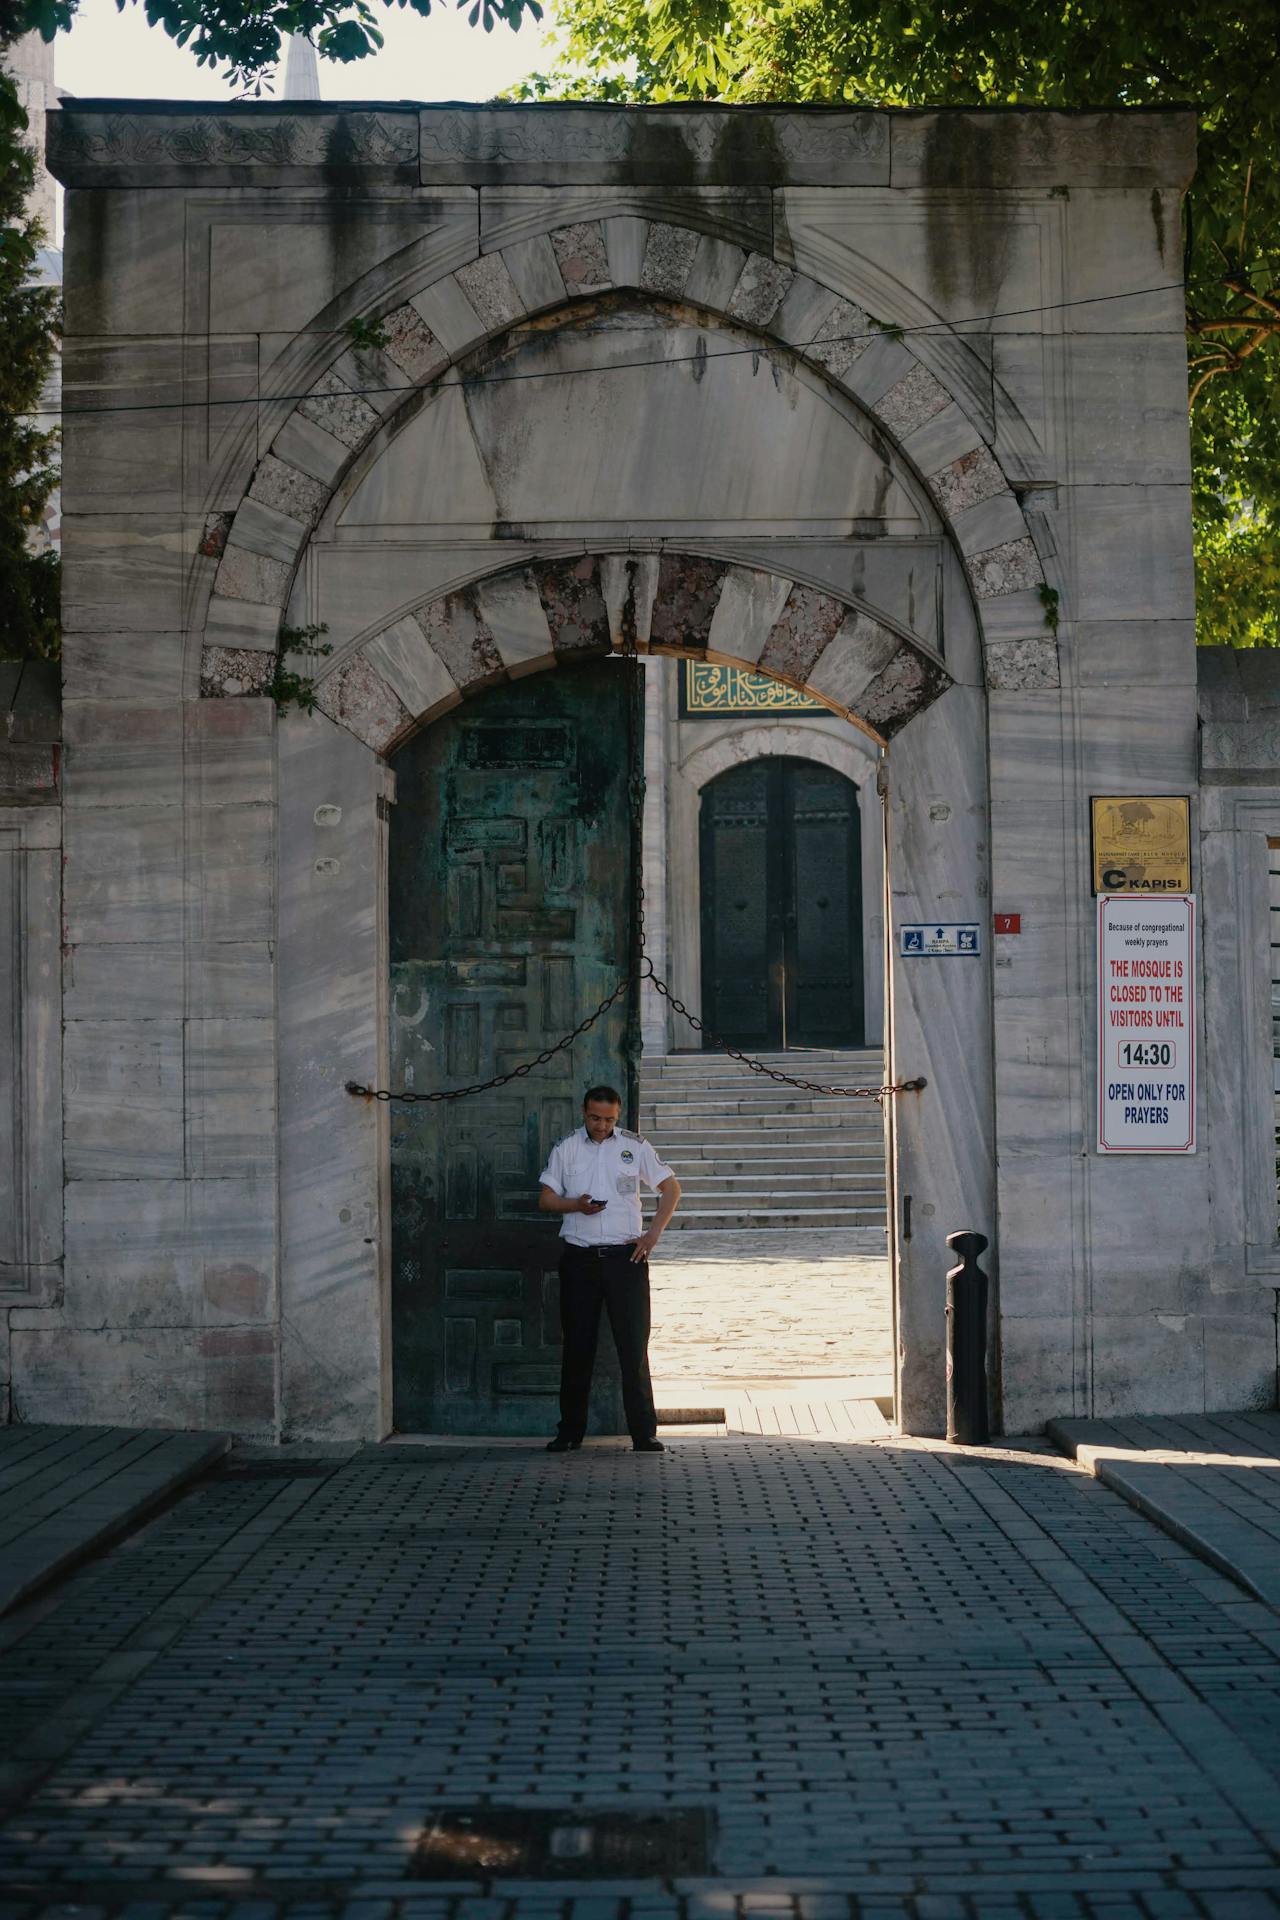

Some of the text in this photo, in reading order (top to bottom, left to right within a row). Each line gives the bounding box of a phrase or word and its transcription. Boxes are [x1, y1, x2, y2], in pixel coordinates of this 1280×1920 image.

[1102, 869, 1182, 889] C KAPISI
[1003, 918, 1011, 929] 7
[1108, 922, 1185, 934] Because of congregational
[1124, 938, 1169, 949] weekly prayers
[1110, 960, 1184, 979] THE MOSQUE IS
[1110, 985, 1183, 1003] CLOSED TO THE
[1110, 1010, 1184, 1027] VISITORS UNTIL
[1123, 1043, 1171, 1066] 14:30
[1108, 1083, 1186, 1101] OPEN ONLY FOR
[1124, 1106, 1169, 1124] PRAYERS
